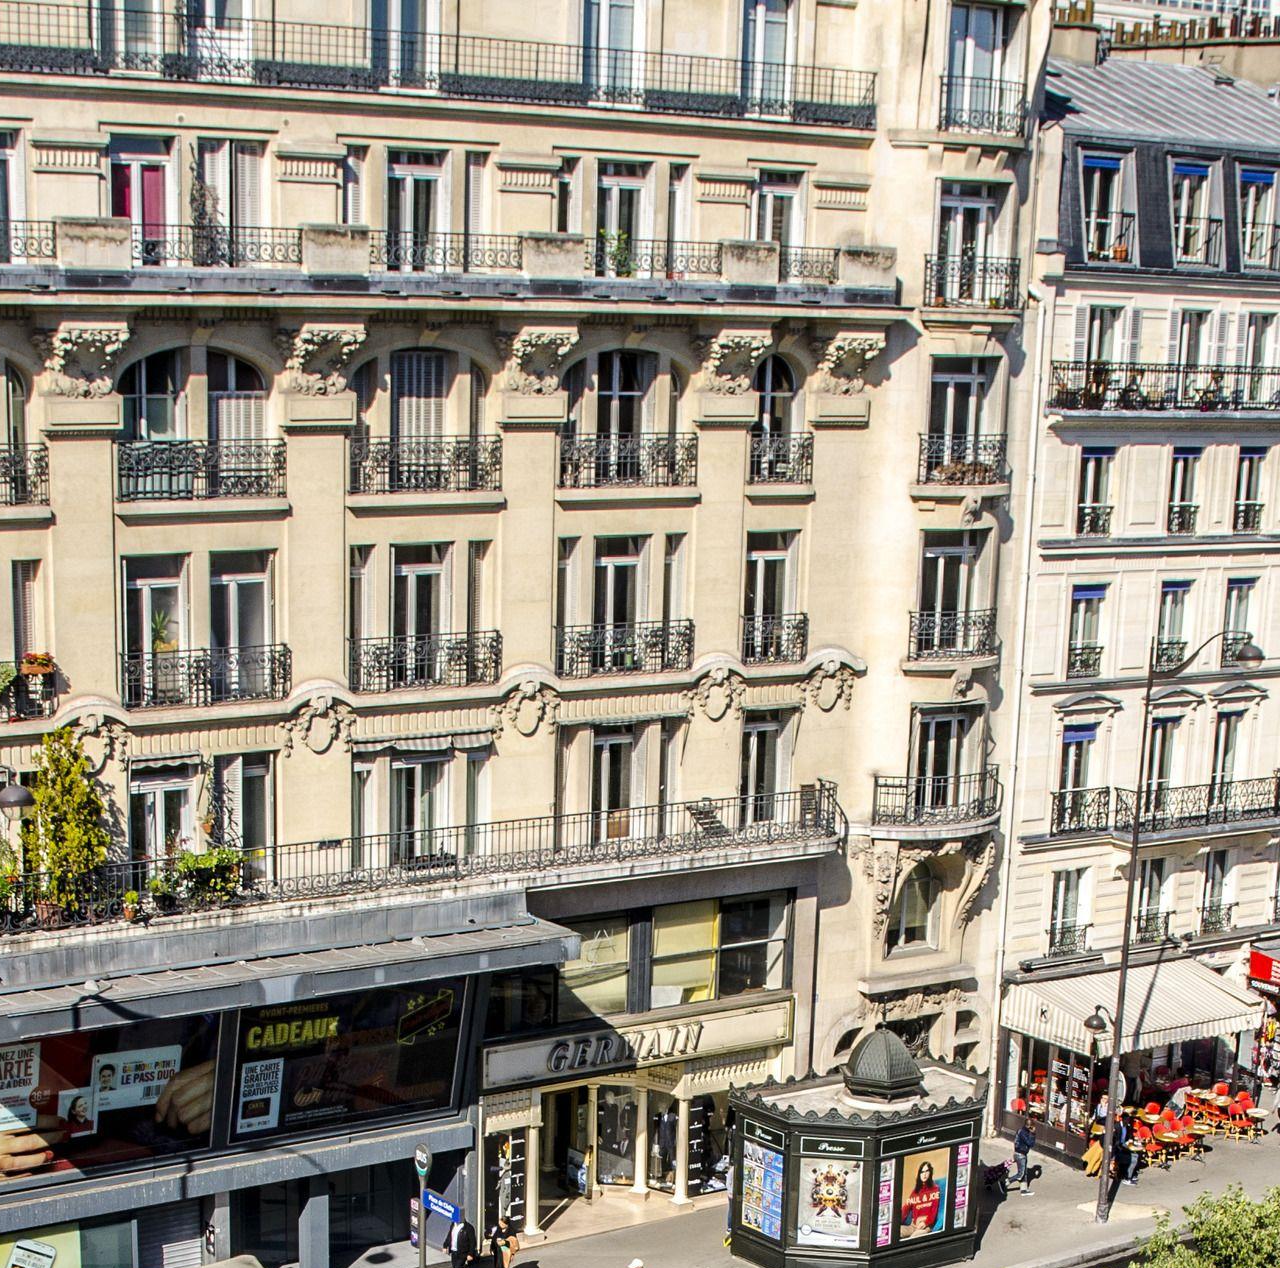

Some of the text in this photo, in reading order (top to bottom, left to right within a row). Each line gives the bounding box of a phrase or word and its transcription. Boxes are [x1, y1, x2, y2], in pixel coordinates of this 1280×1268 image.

[247, 1016, 339, 1049] CADEAUX
[18, 1047, 35, 1059] UNE
[547, 1022, 704, 1073] GERMAIN
[245, 1062, 281, 1074] UNE CARTE
[6, 1080, 12, 1089] A
[13, 1078, 33, 1088] DEUX
[121, 1074, 131, 1085] LE
[133, 1071, 154, 1083] PASS
[244, 1071, 279, 1085] GRATUITE
[242, 1086, 279, 1098] GRATUITES
[818, 1142, 846, 1152] Presse
[906, 1197, 921, 1206] PAUL
[929, 1191, 941, 1200] JOE
